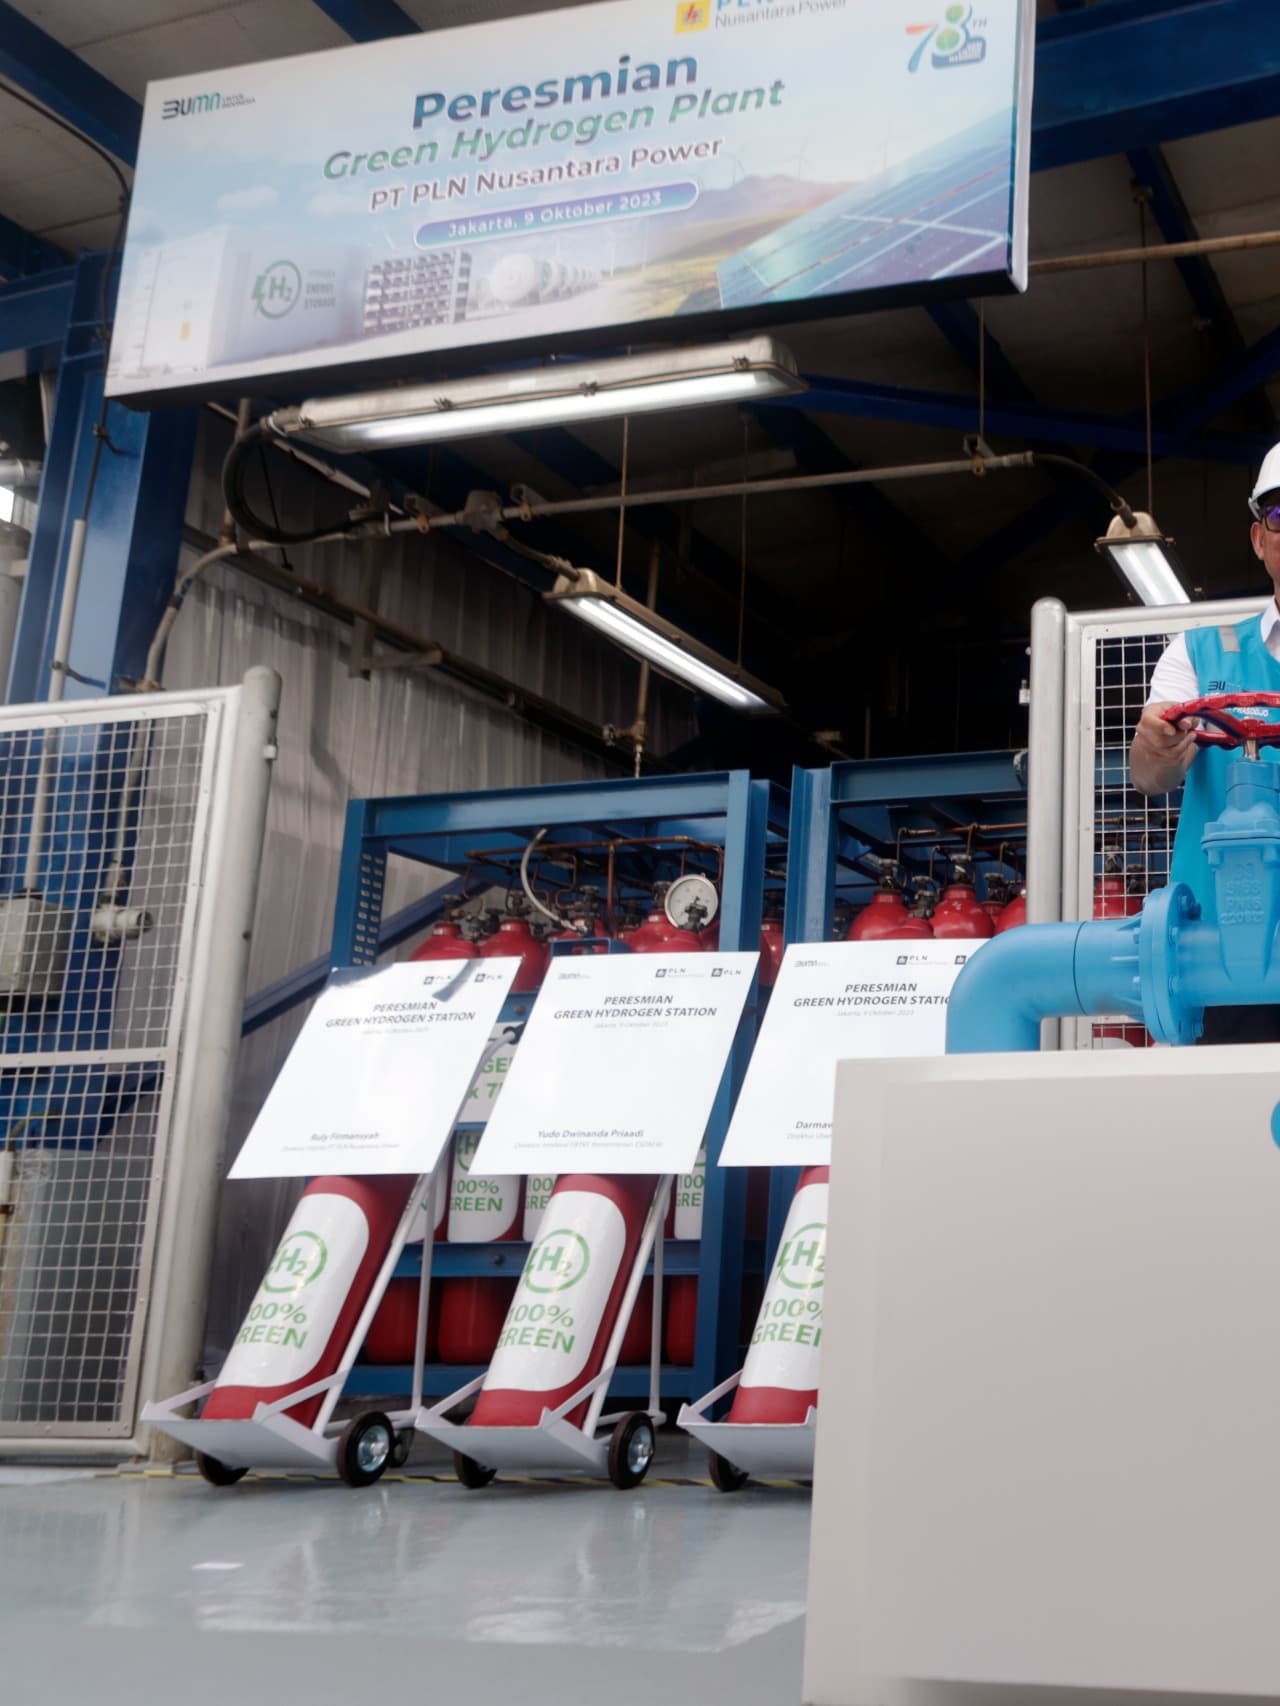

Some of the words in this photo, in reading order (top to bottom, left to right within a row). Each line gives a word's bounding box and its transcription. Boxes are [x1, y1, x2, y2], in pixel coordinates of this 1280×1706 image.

[715, 6, 796, 30] Nusantara
[798, 0, 847, 15] Power
[412, 55, 698, 130] Peresmian
[323, 140, 440, 180] Green
[451, 106, 655, 162] Hydrogen
[668, 79, 785, 123] Plant
[371, 187, 405, 211] PT
[412, 176, 467, 204] PLN
[476, 155, 620, 193] Nusantara
[631, 139, 723, 169] Power
[448, 214, 519, 238] Jakarta,
[523, 212, 535, 226] 9
[540, 201, 614, 223] Oktober
[619, 191, 662, 211] 2023
[845, 983, 918, 993] PERESMIAN
[373, 1001, 437, 1013] PERESMIAN
[603, 994, 674, 1006] PERESMIAN
[793, 996, 834, 1008] GREEN
[836, 995, 908, 1006] HYDROGEN
[910, 995, 951, 1006] STATI
[325, 1016, 361, 1028] GREEN
[363, 1014, 425, 1026] HYDROGEN
[427, 1011, 476, 1023] STATION
[553, 1009, 593, 1020] GREEN
[594, 1008, 663, 1018] HYDROGEN
[664, 1006, 718, 1017] STATION
[248, 1302, 307, 1324] 00%
[507, 1303, 574, 1328] 100%
[236, 1324, 309, 1350] REEN
